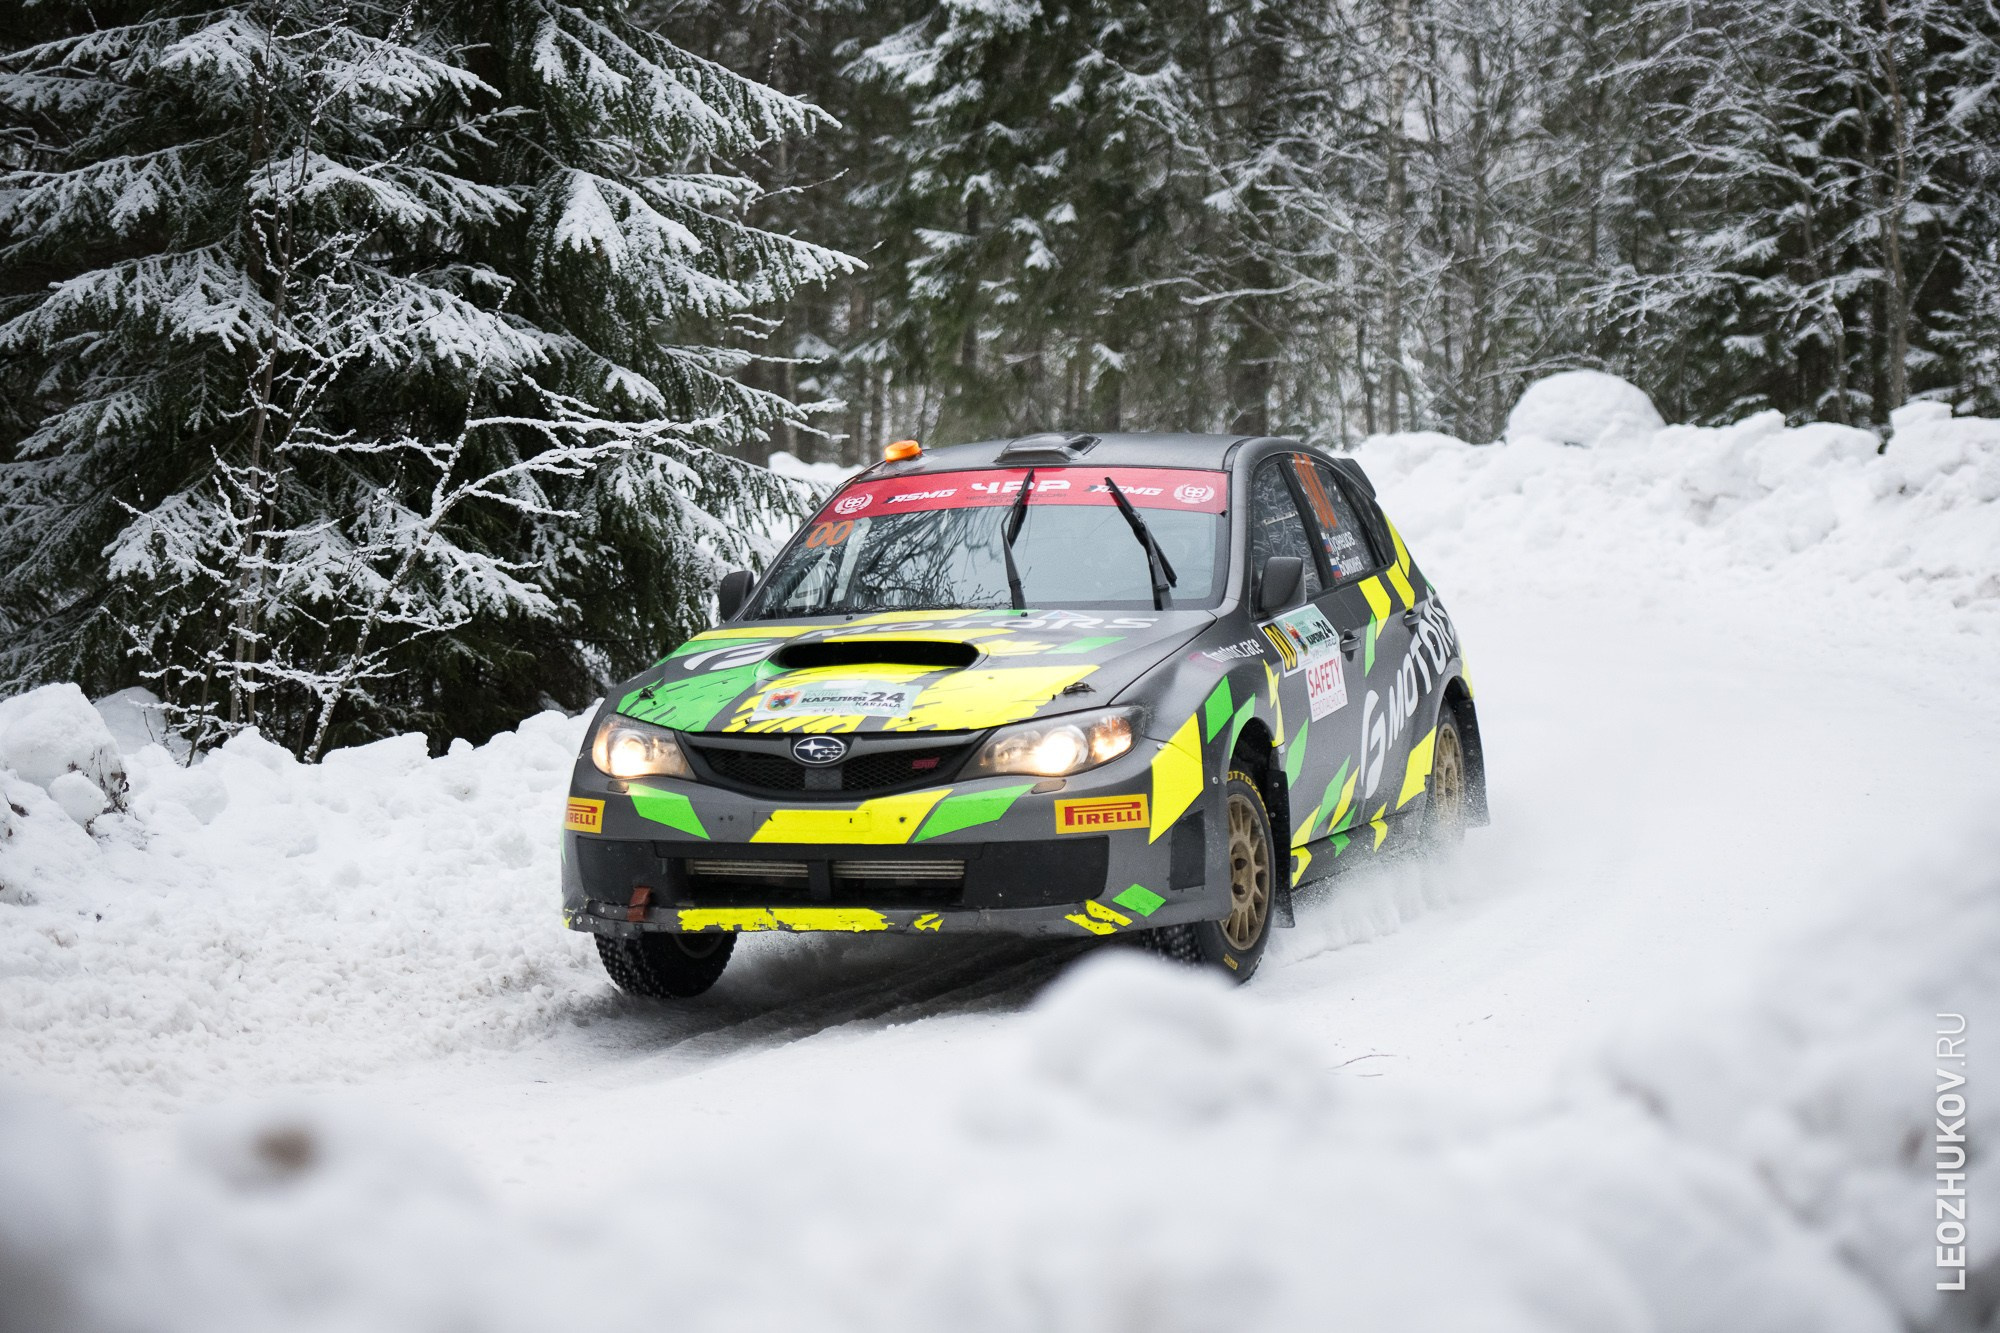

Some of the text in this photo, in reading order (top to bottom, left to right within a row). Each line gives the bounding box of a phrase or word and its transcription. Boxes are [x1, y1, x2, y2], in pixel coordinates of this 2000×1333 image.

[805, 520, 855, 548] 00
[1308, 656, 1341, 698] SAFETY
[1064, 802, 1142, 826] PIRELLI
